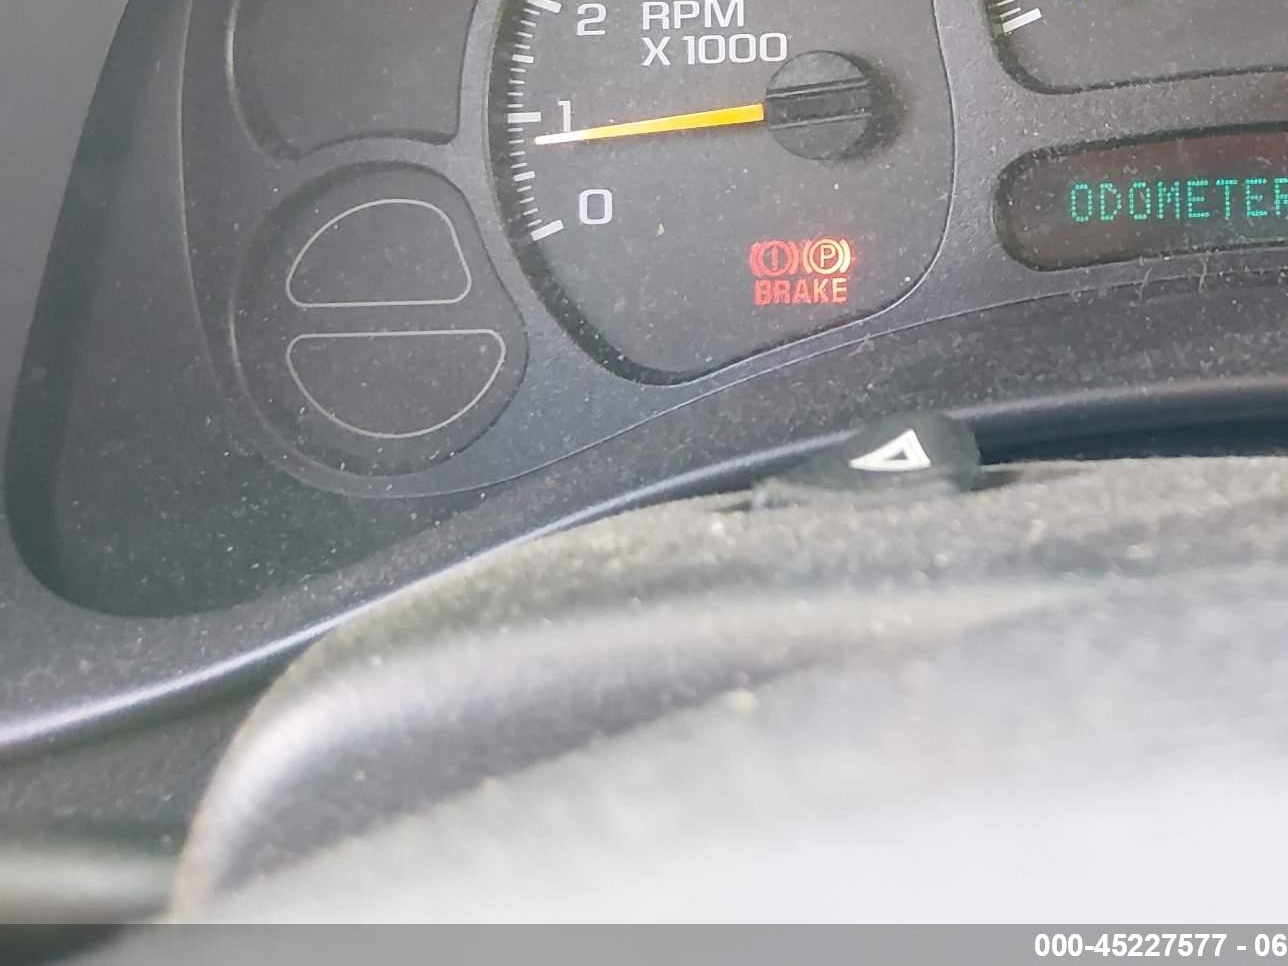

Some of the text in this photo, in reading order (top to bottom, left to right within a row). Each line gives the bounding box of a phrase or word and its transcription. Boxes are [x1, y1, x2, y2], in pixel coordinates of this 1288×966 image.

[576, 3, 607, 36] 2
[682, 32, 788, 65] 1000
[556, 100, 573, 133] 1
[578, 188, 613, 225] 0
[754, 277, 848, 306] BRAKE
